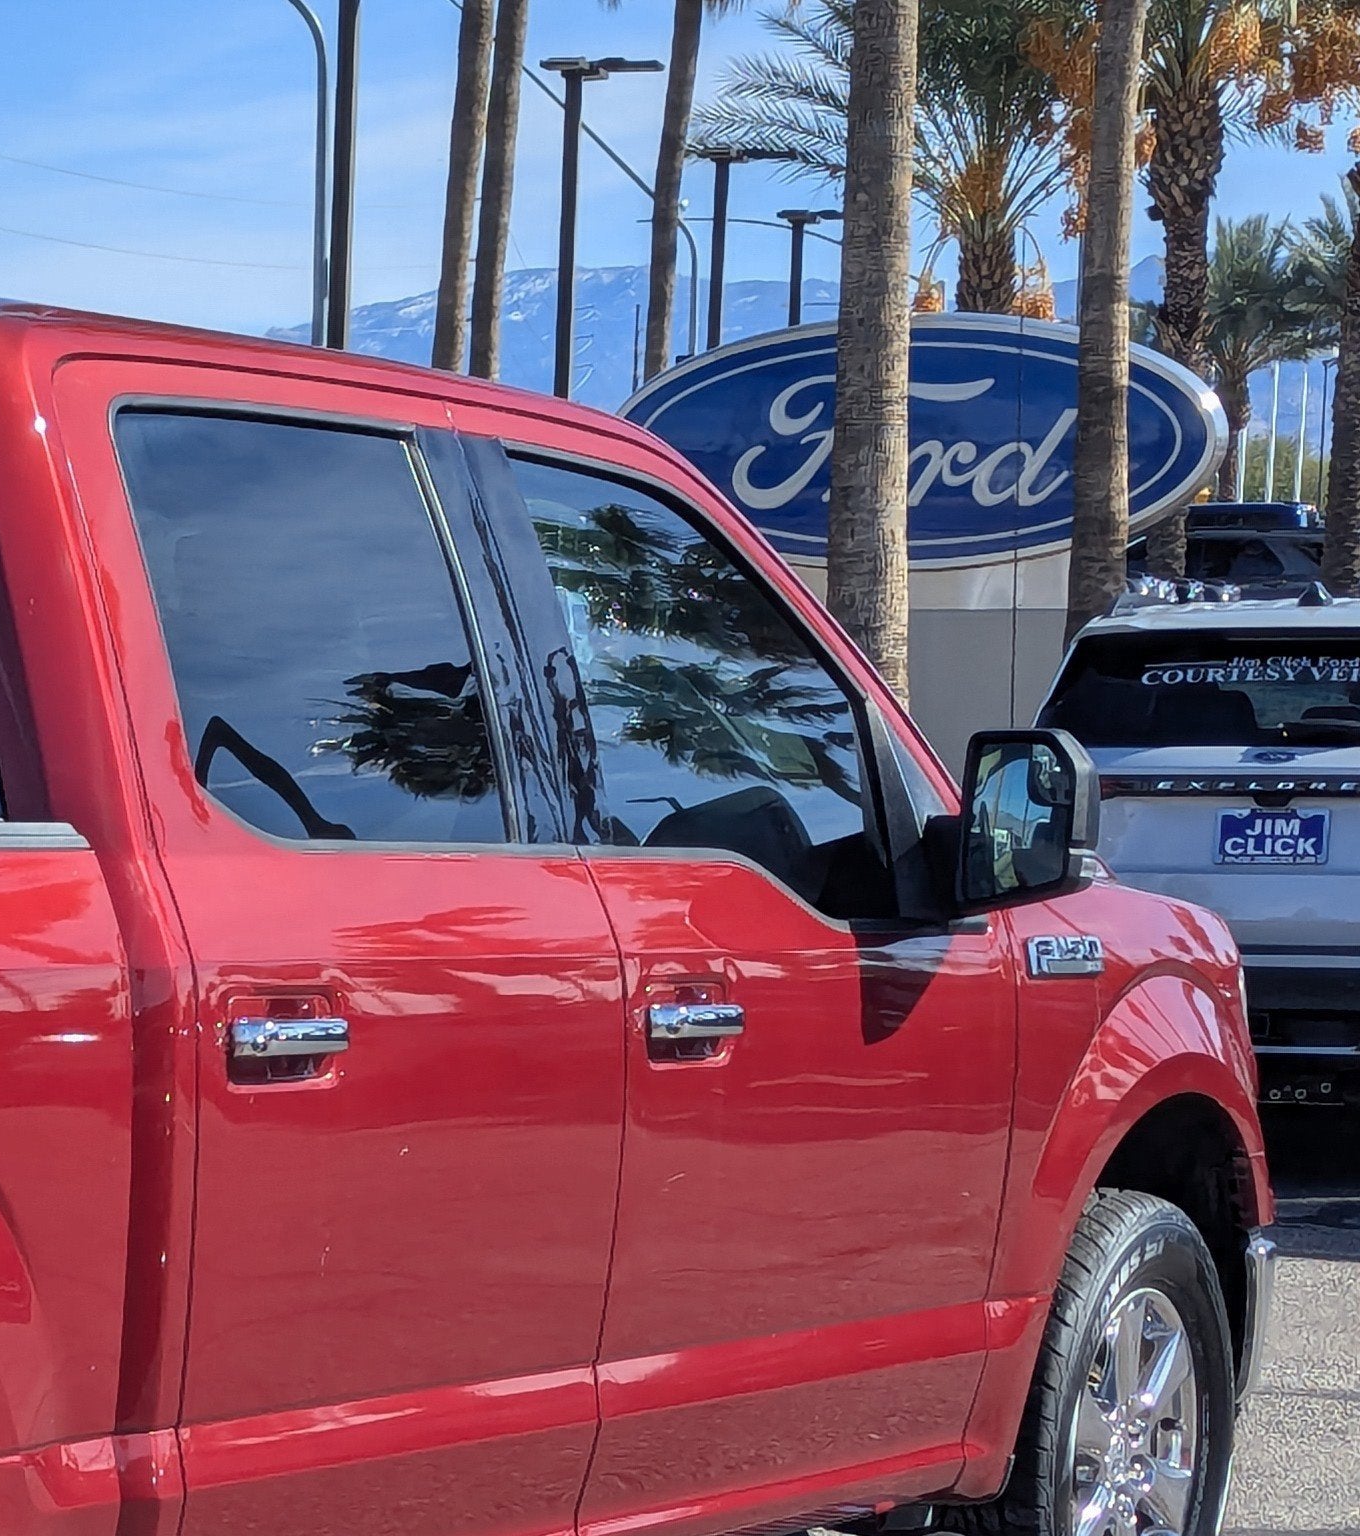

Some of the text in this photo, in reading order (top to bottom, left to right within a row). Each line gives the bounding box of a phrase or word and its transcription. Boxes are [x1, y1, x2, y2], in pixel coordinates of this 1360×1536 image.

[732, 374, 1079, 509] Frd
[1319, 656, 1360, 667] Ford
[1141, 666, 1303, 685] COURTESY
[1245, 818, 1301, 836] JIM
[1224, 837, 1318, 856] CLICK
